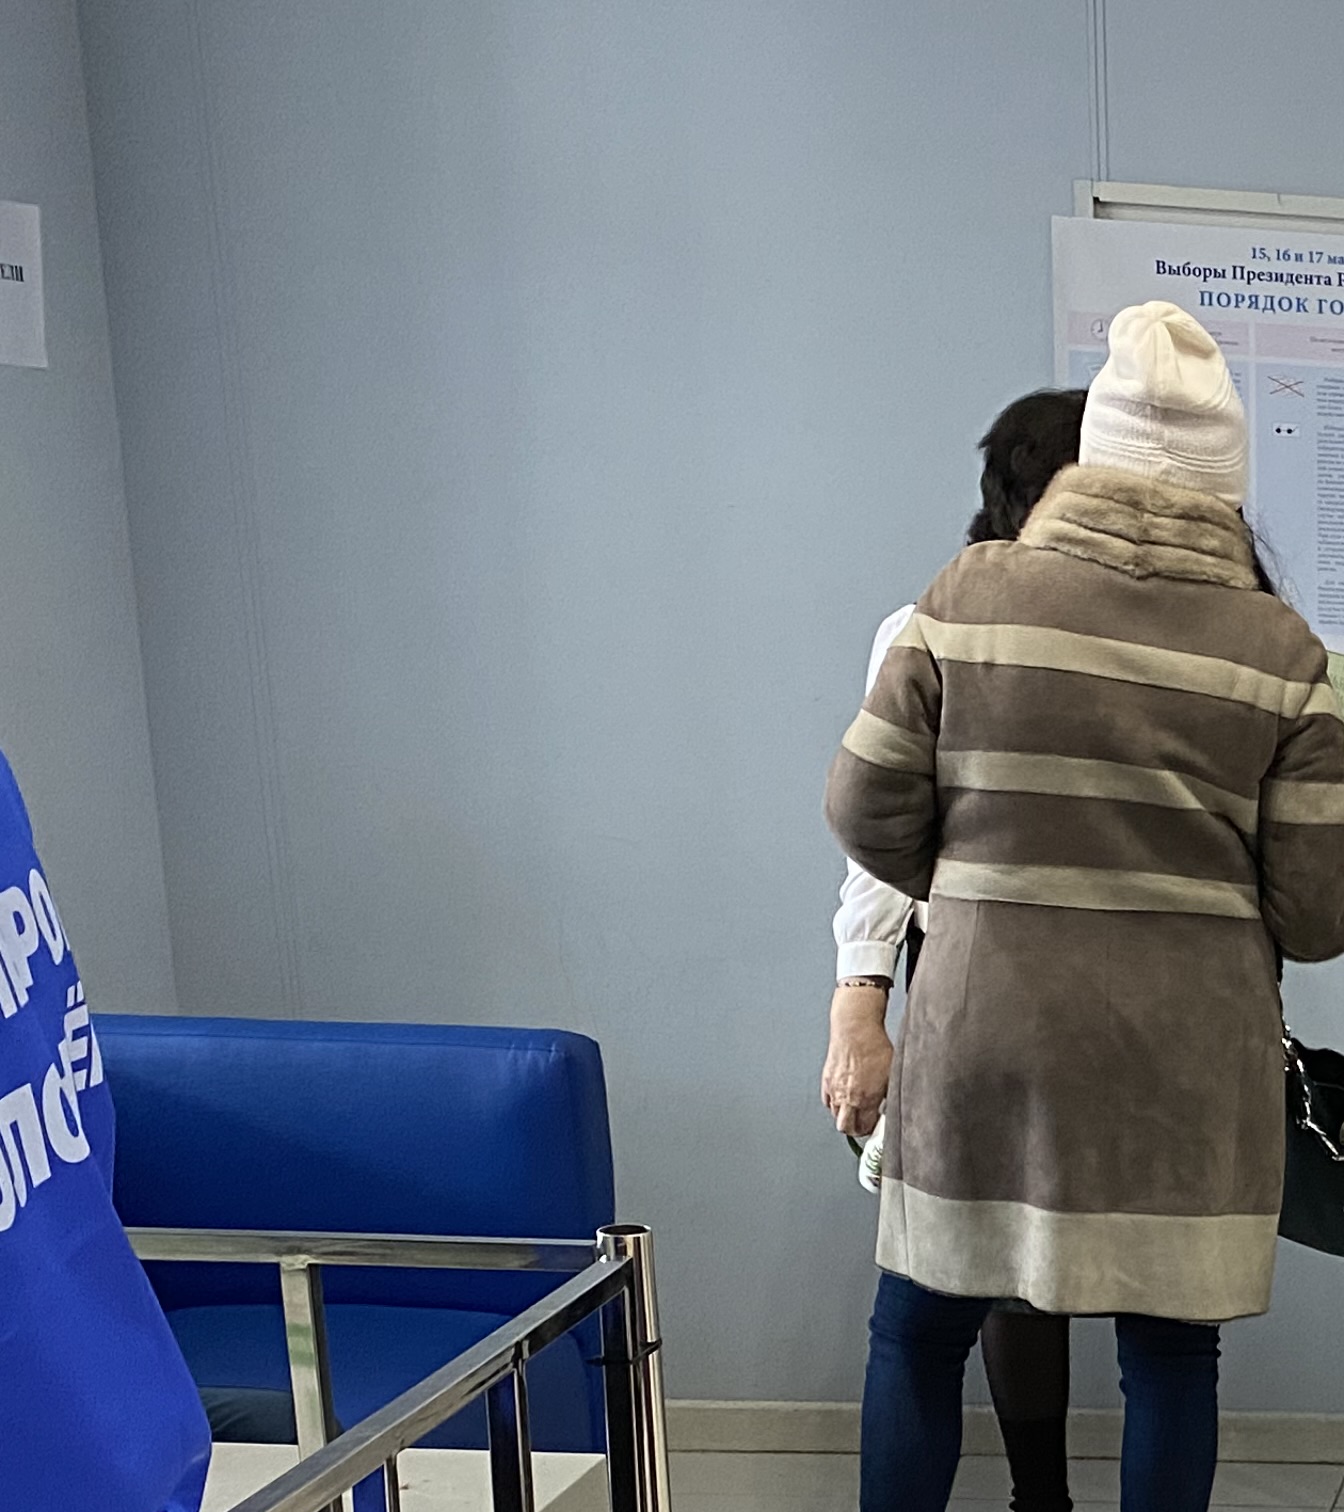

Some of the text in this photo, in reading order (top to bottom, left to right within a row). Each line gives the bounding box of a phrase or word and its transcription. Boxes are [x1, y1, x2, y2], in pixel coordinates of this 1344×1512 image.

[1251, 247, 1270, 263] 15,
[1275, 248, 1291, 262] 16
[1295, 253, 1303, 263] и
[1308, 251, 1323, 264] 17
[1155, 260, 1227, 282] Выборы
[1232, 266, 1332, 287] Президента
[1199, 291, 1309, 314] ПОРЯДОК
